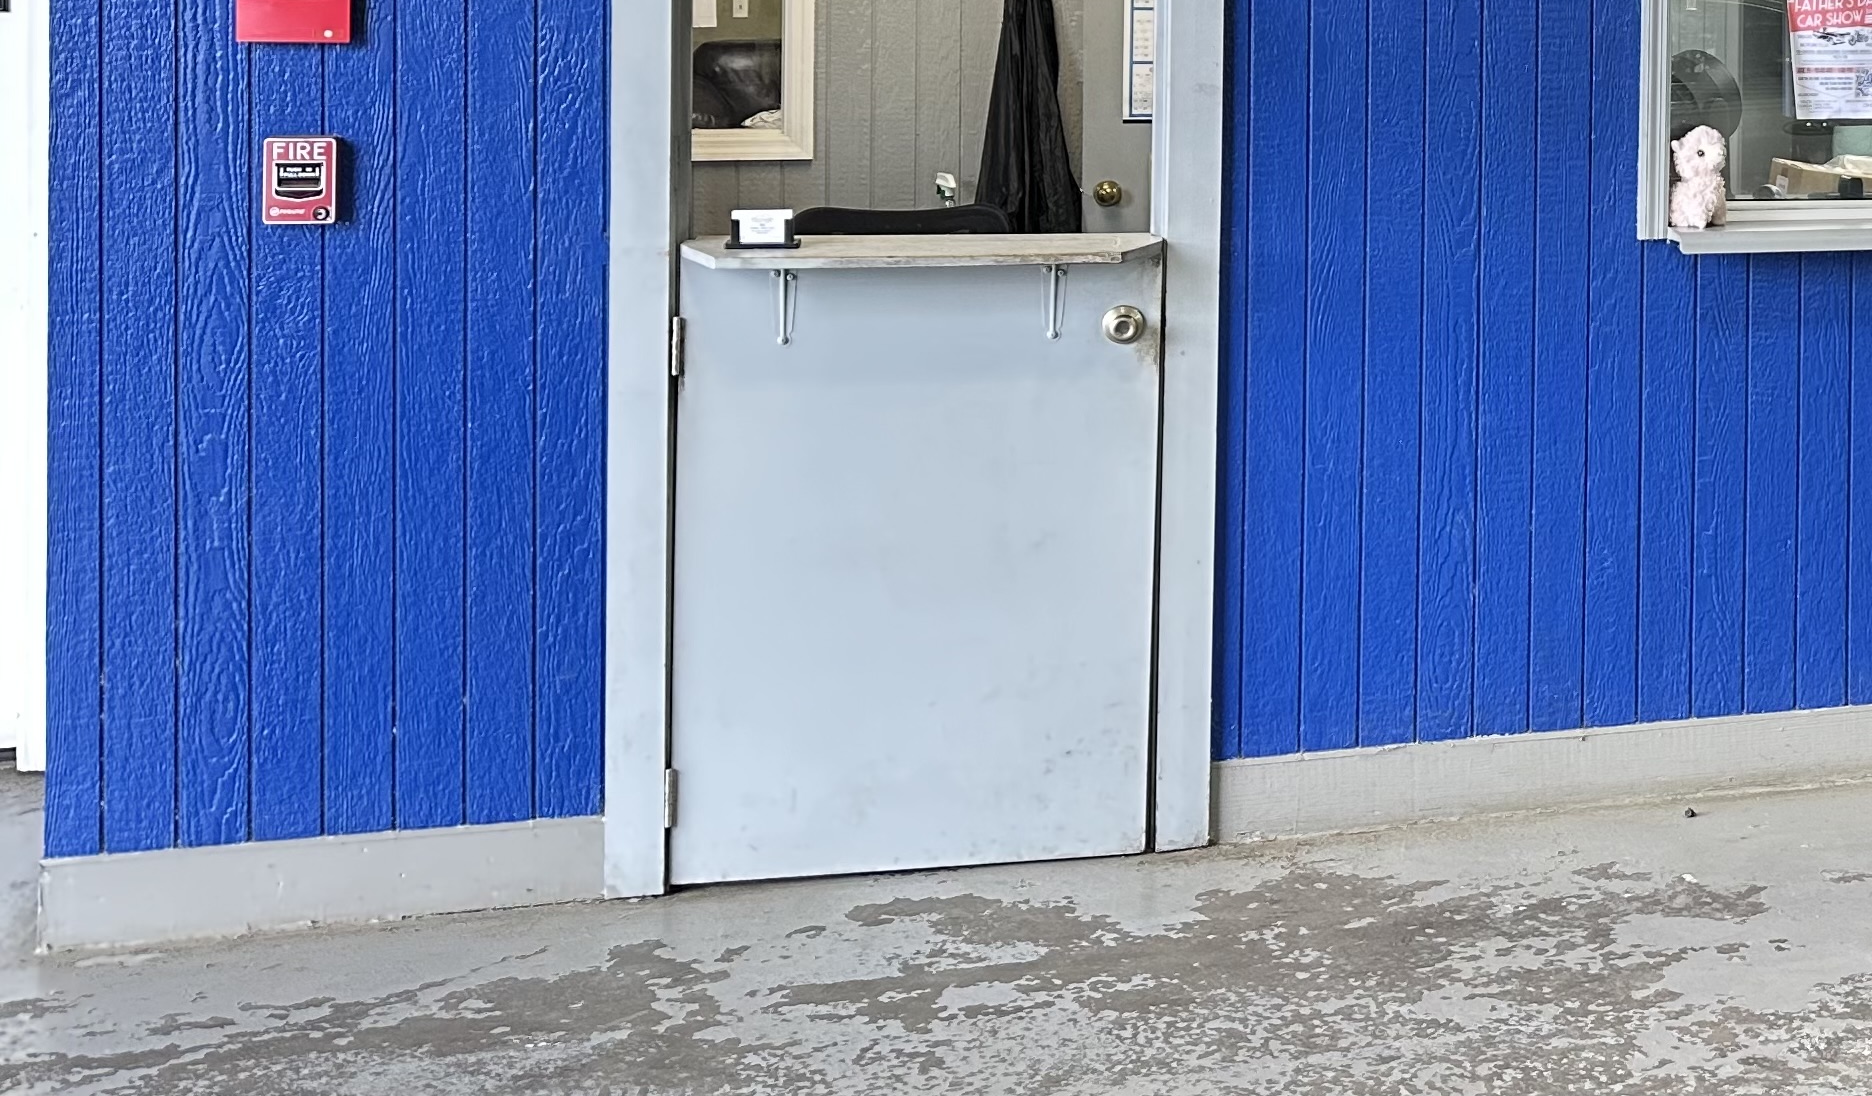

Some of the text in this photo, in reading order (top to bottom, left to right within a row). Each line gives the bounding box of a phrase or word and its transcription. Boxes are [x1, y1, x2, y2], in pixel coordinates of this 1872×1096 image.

[1796, 13, 1822, 28] CAR
[1825, 9, 1864, 26] SHOW
[272, 142, 327, 160] FIRE
